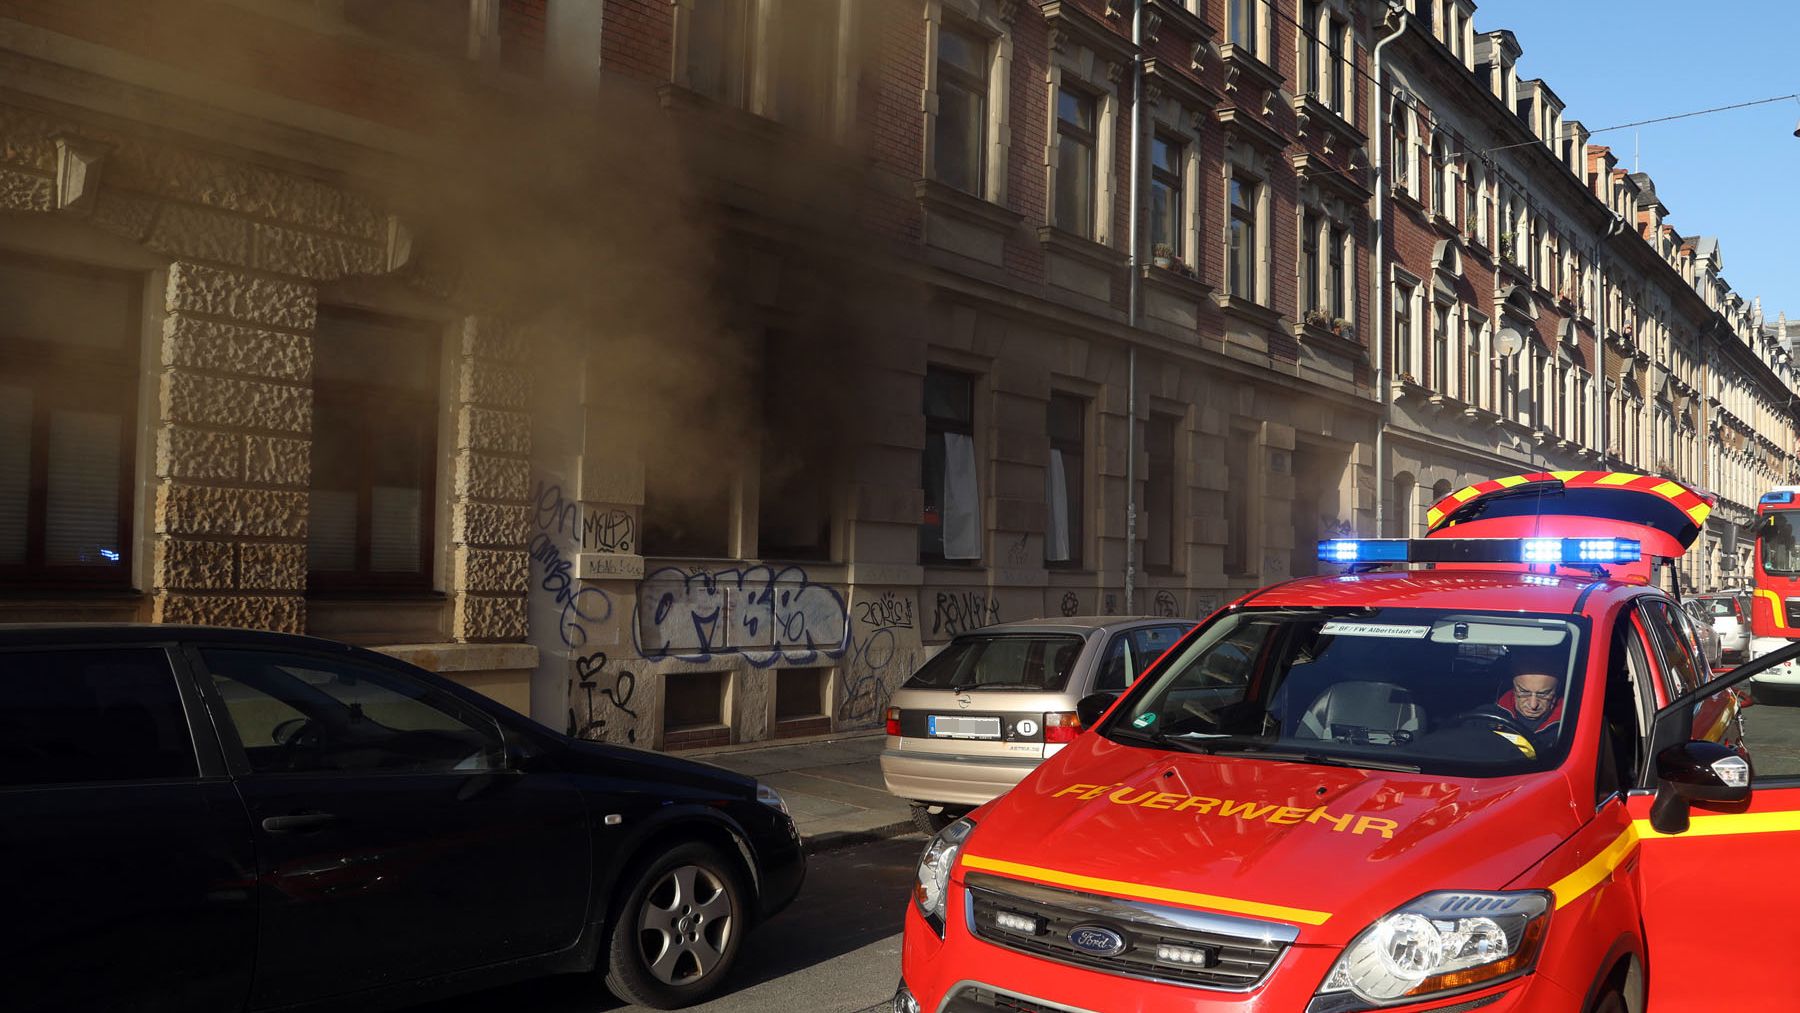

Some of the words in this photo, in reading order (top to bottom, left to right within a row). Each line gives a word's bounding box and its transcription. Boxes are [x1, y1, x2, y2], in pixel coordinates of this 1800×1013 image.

[1023, 722, 1032, 733] D
[1051, 782, 1400, 839] FEUERWEHR
[1078, 930, 1110, 949] Ford
